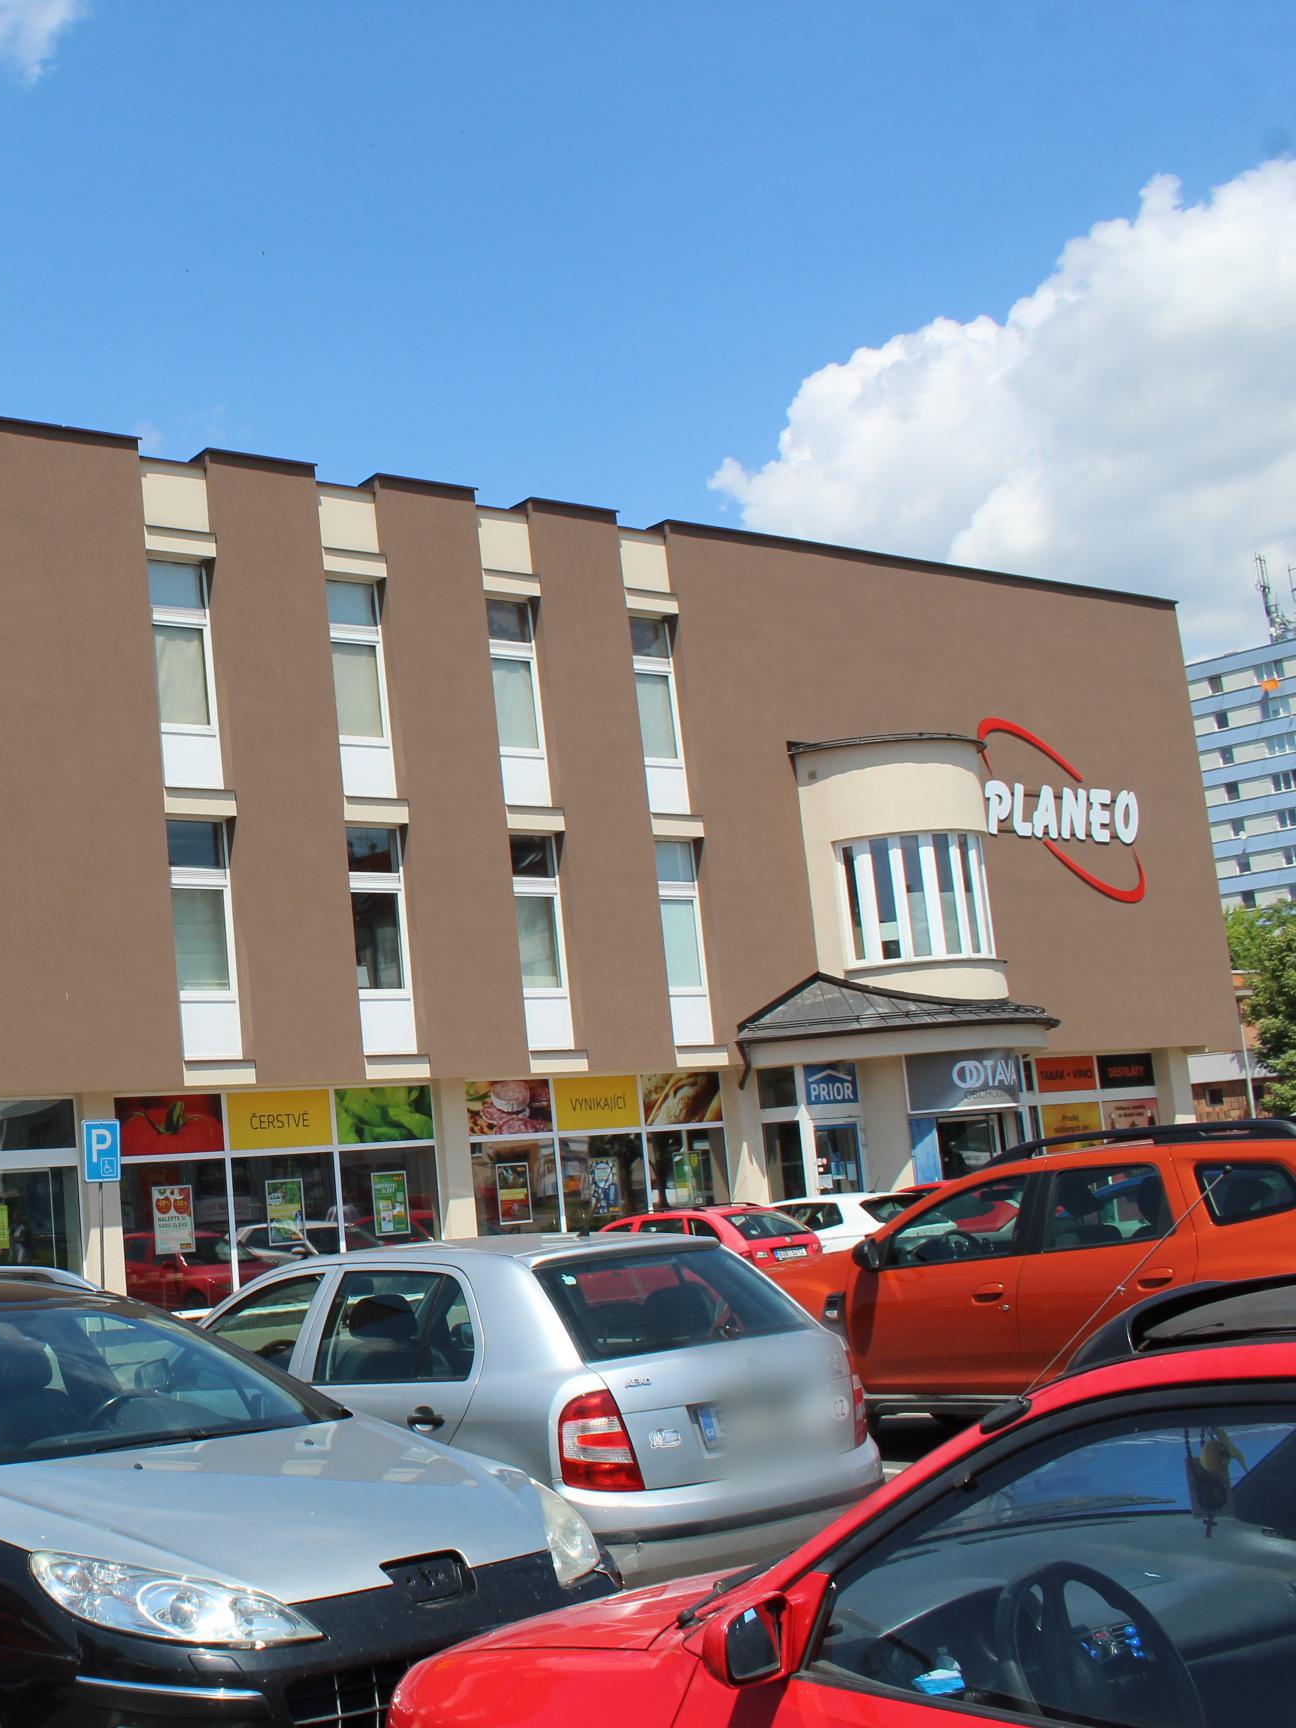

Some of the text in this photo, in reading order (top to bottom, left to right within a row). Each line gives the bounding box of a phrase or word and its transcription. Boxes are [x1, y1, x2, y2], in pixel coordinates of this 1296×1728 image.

[984, 780, 1140, 845] PLANEO
[809, 1082, 854, 1102] PRIOR
[569, 1093, 626, 1113] VYNIKAJÍCÍ
[250, 1110, 311, 1130] ČERSTVÉ
[91, 1128, 112, 1163] P
[833, 1399, 846, 1418] CZ
